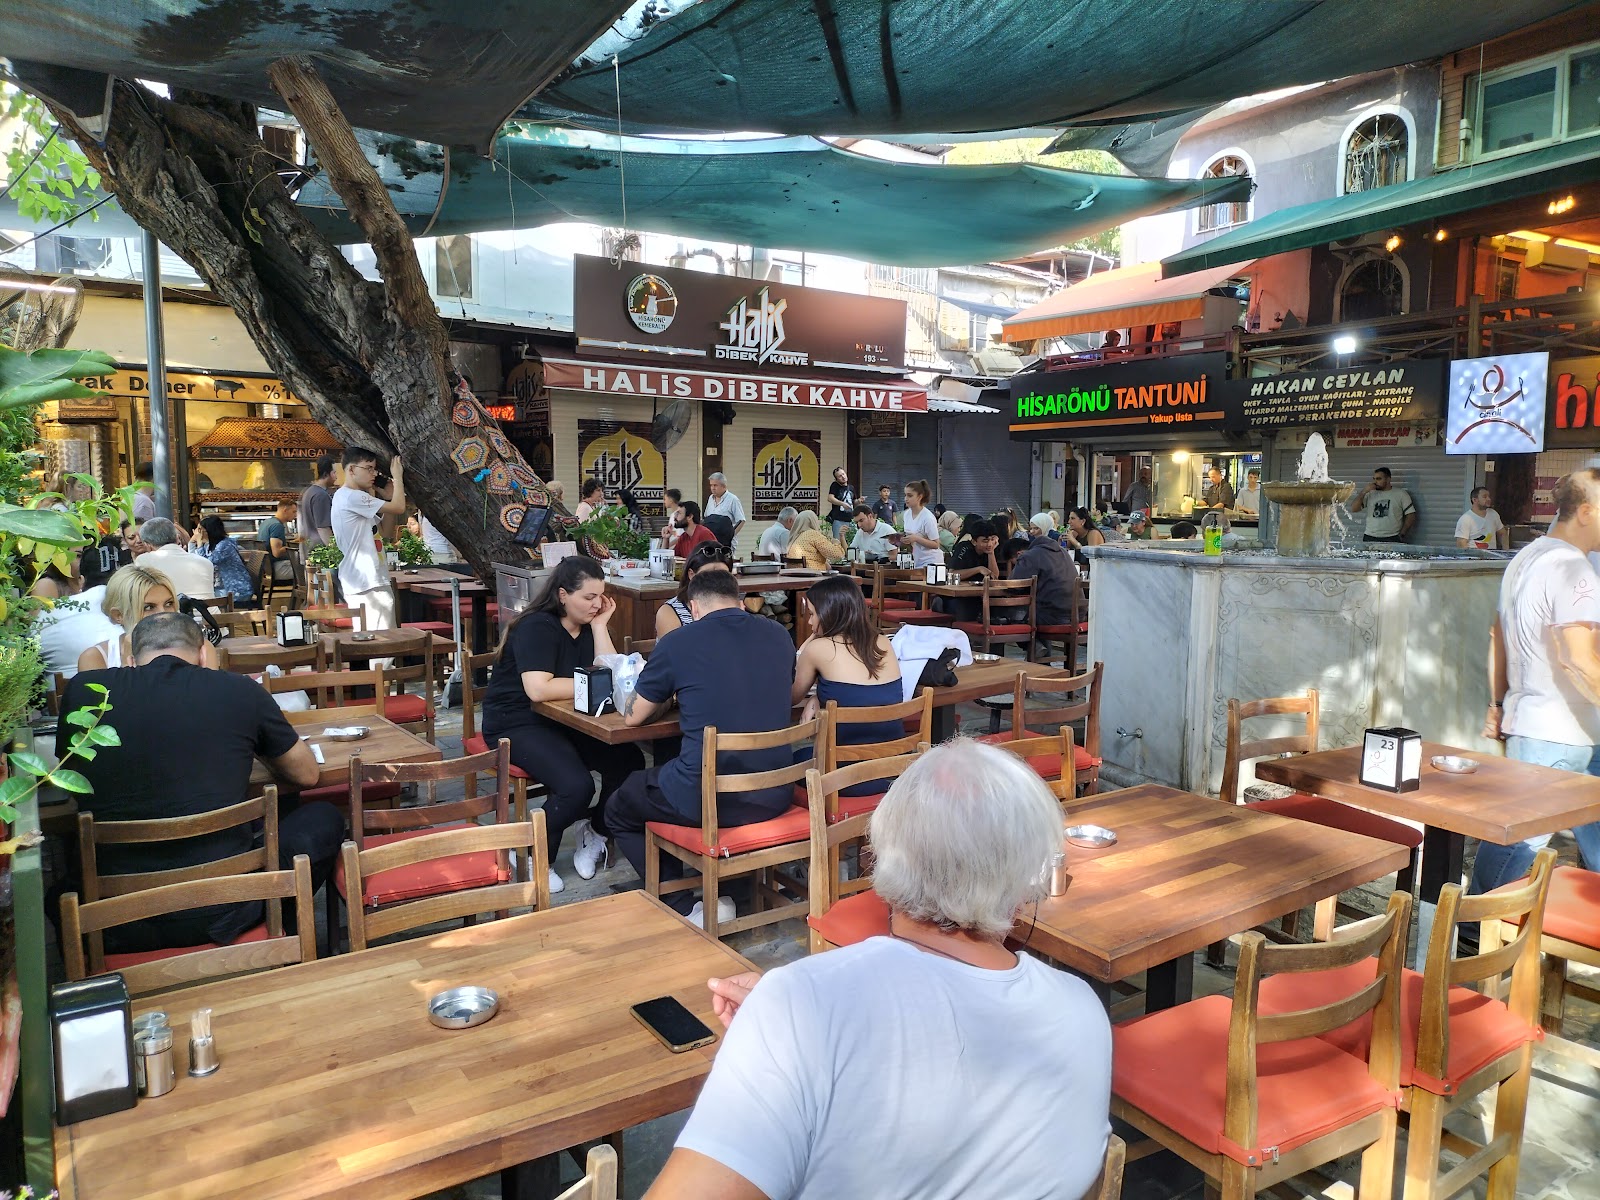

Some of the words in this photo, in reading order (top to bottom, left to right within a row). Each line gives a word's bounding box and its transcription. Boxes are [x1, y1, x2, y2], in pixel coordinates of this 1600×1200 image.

[769, 354, 809, 366] KAHVE
[1250, 377, 1317, 397] HAKAN
[1323, 368, 1405, 390] CEYLAN
[809, 386, 903, 410] KAHVE
[1017, 384, 1110, 418] HİSARÖNÜ
[1113, 374, 1207, 410] TANTUNİ
[1243, 400, 1262, 408] OKEY
[1268, 397, 1291, 405] TAVLA
[1298, 394, 1321, 403] OYUN
[1322, 390, 1367, 400] KAĞITLARI
[1374, 386, 1414, 396] SATRANÇ
[1244, 407, 1276, 416] BİLARDO
[1277, 401, 1334, 413] MALZEMELERİ
[1341, 400, 1364, 409] ÇUHA
[1150, 413, 1174, 425] Yakup
[1250, 415, 1288, 426] TOPTAN
[1298, 409, 1363, 422] PERAKENDE
[1365, 406, 1403, 418] SATIŞI
[1337, 427, 1371, 439] HAKAN
[1372, 426, 1411, 439] CEYLAN
[632, 490, 664, 498] KAHVE
[793, 490, 818, 498] KAHVE
[1380, 739, 1395, 751] 23
